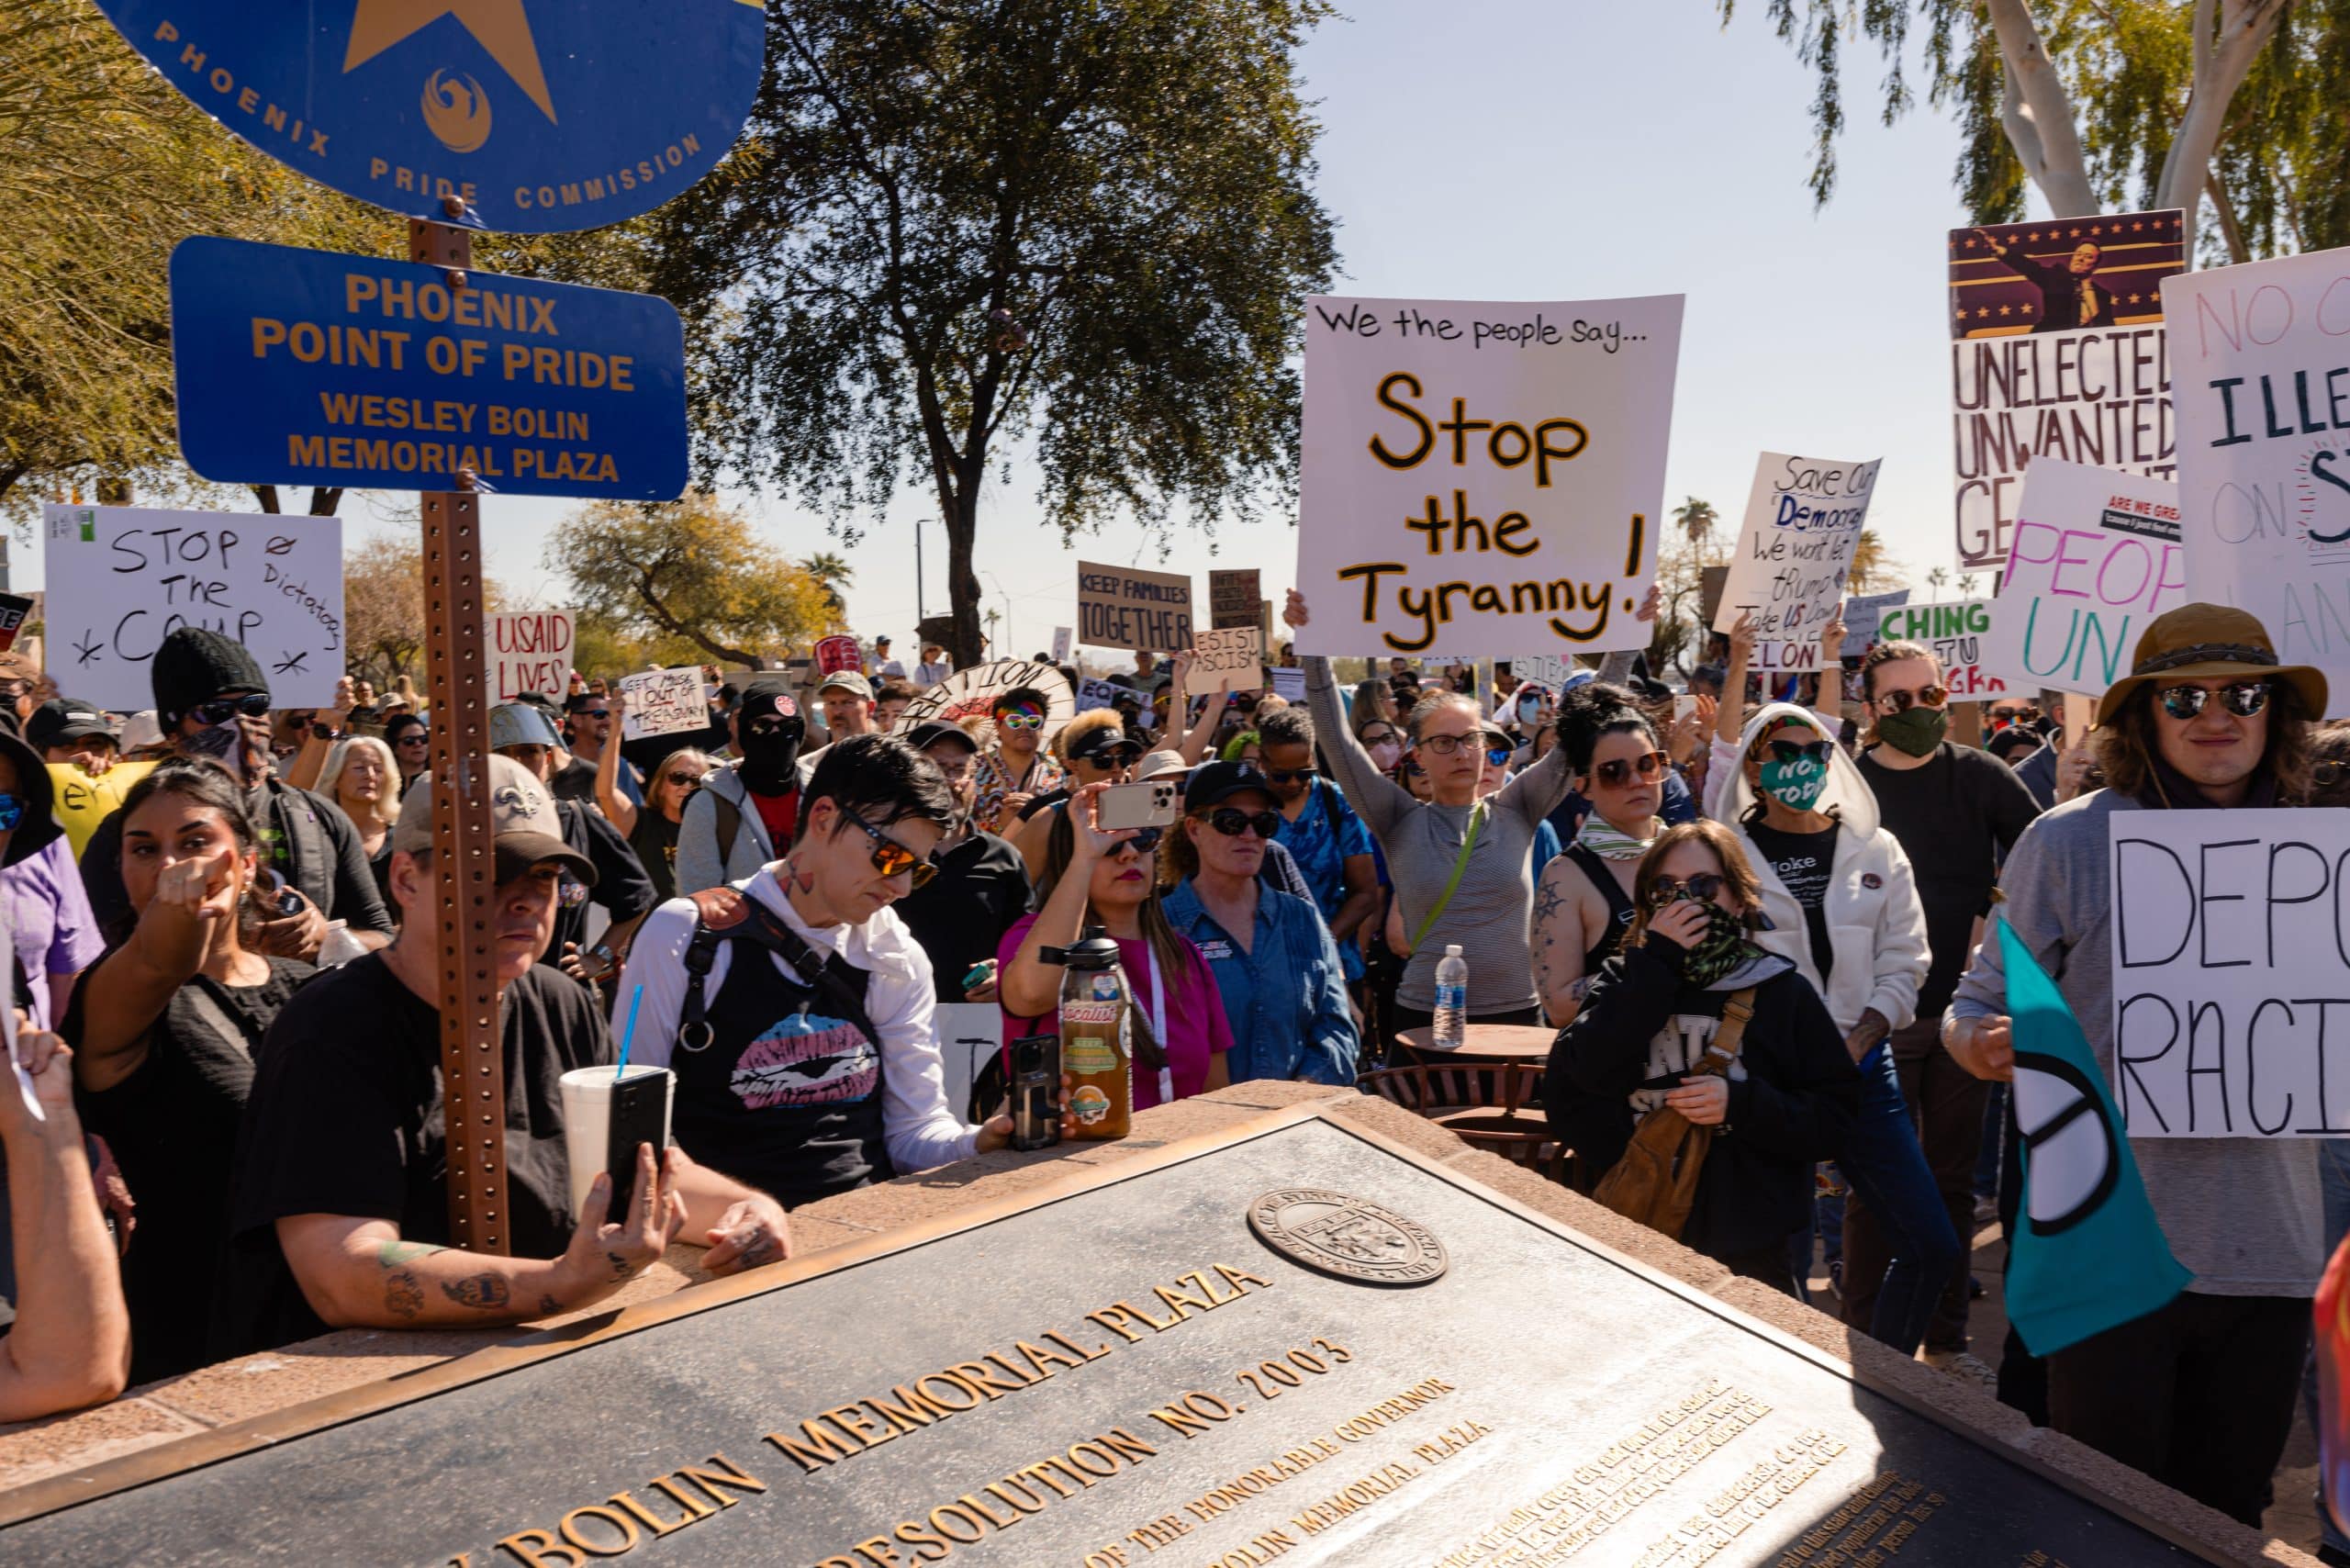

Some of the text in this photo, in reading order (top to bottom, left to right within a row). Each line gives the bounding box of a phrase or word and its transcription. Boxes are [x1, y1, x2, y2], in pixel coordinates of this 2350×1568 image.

[154, 20, 701, 209] PHOENIX PRIDE COMMISSION
[347, 274, 558, 336] PHOENIX
[1315, 303, 1381, 338] We
[1393, 308, 1463, 341] the
[1472, 313, 1562, 350] people
[2197, 285, 2293, 358] NO
[252, 318, 634, 392] POINT OF PRIDE
[320, 392, 589, 441] WESLEY BOLIN
[1368, 371, 1590, 488] Stop
[289, 434, 619, 483] MEMORIAL PLAZA
[1774, 456, 1842, 496] Save
[1404, 489, 1541, 556] the
[2212, 482, 2287, 544] ON
[112, 527, 239, 573] STOP
[1754, 532, 1785, 562] We
[160, 574, 232, 608] The
[1080, 572, 1119, 596] KEEP
[1124, 579, 1188, 605] FAMILIES
[114, 610, 263, 661] CP
[496, 614, 571, 655] USAID
[1079, 602, 1193, 653] TOGETHER
[1784, 602, 1807, 628] US
[1882, 603, 1990, 641] CHING
[1195, 629, 1258, 652] ESIST
[1748, 643, 1817, 668] ELON
[1933, 636, 1979, 666] TU
[498, 659, 564, 700] LIVES
[645, 686, 673, 705] OUT
[632, 704, 705, 730] TREASURY
[494, 1261, 1274, 1568] BOLIN MEMORIAL PLAZA
[811, 1337, 1352, 1568] ESOLUTION NO. 2003
[1083, 1377, 1456, 1568] OF THE HONORABLE GOVERNOR
[1206, 1418, 1494, 1568] OLIN MEMORIAL PLAZA
[1879, 1495, 1908, 1515] the
[1801, 1528, 1833, 1550] this
[1821, 1510, 1857, 1534] state
[1877, 1519, 1918, 1555] person
